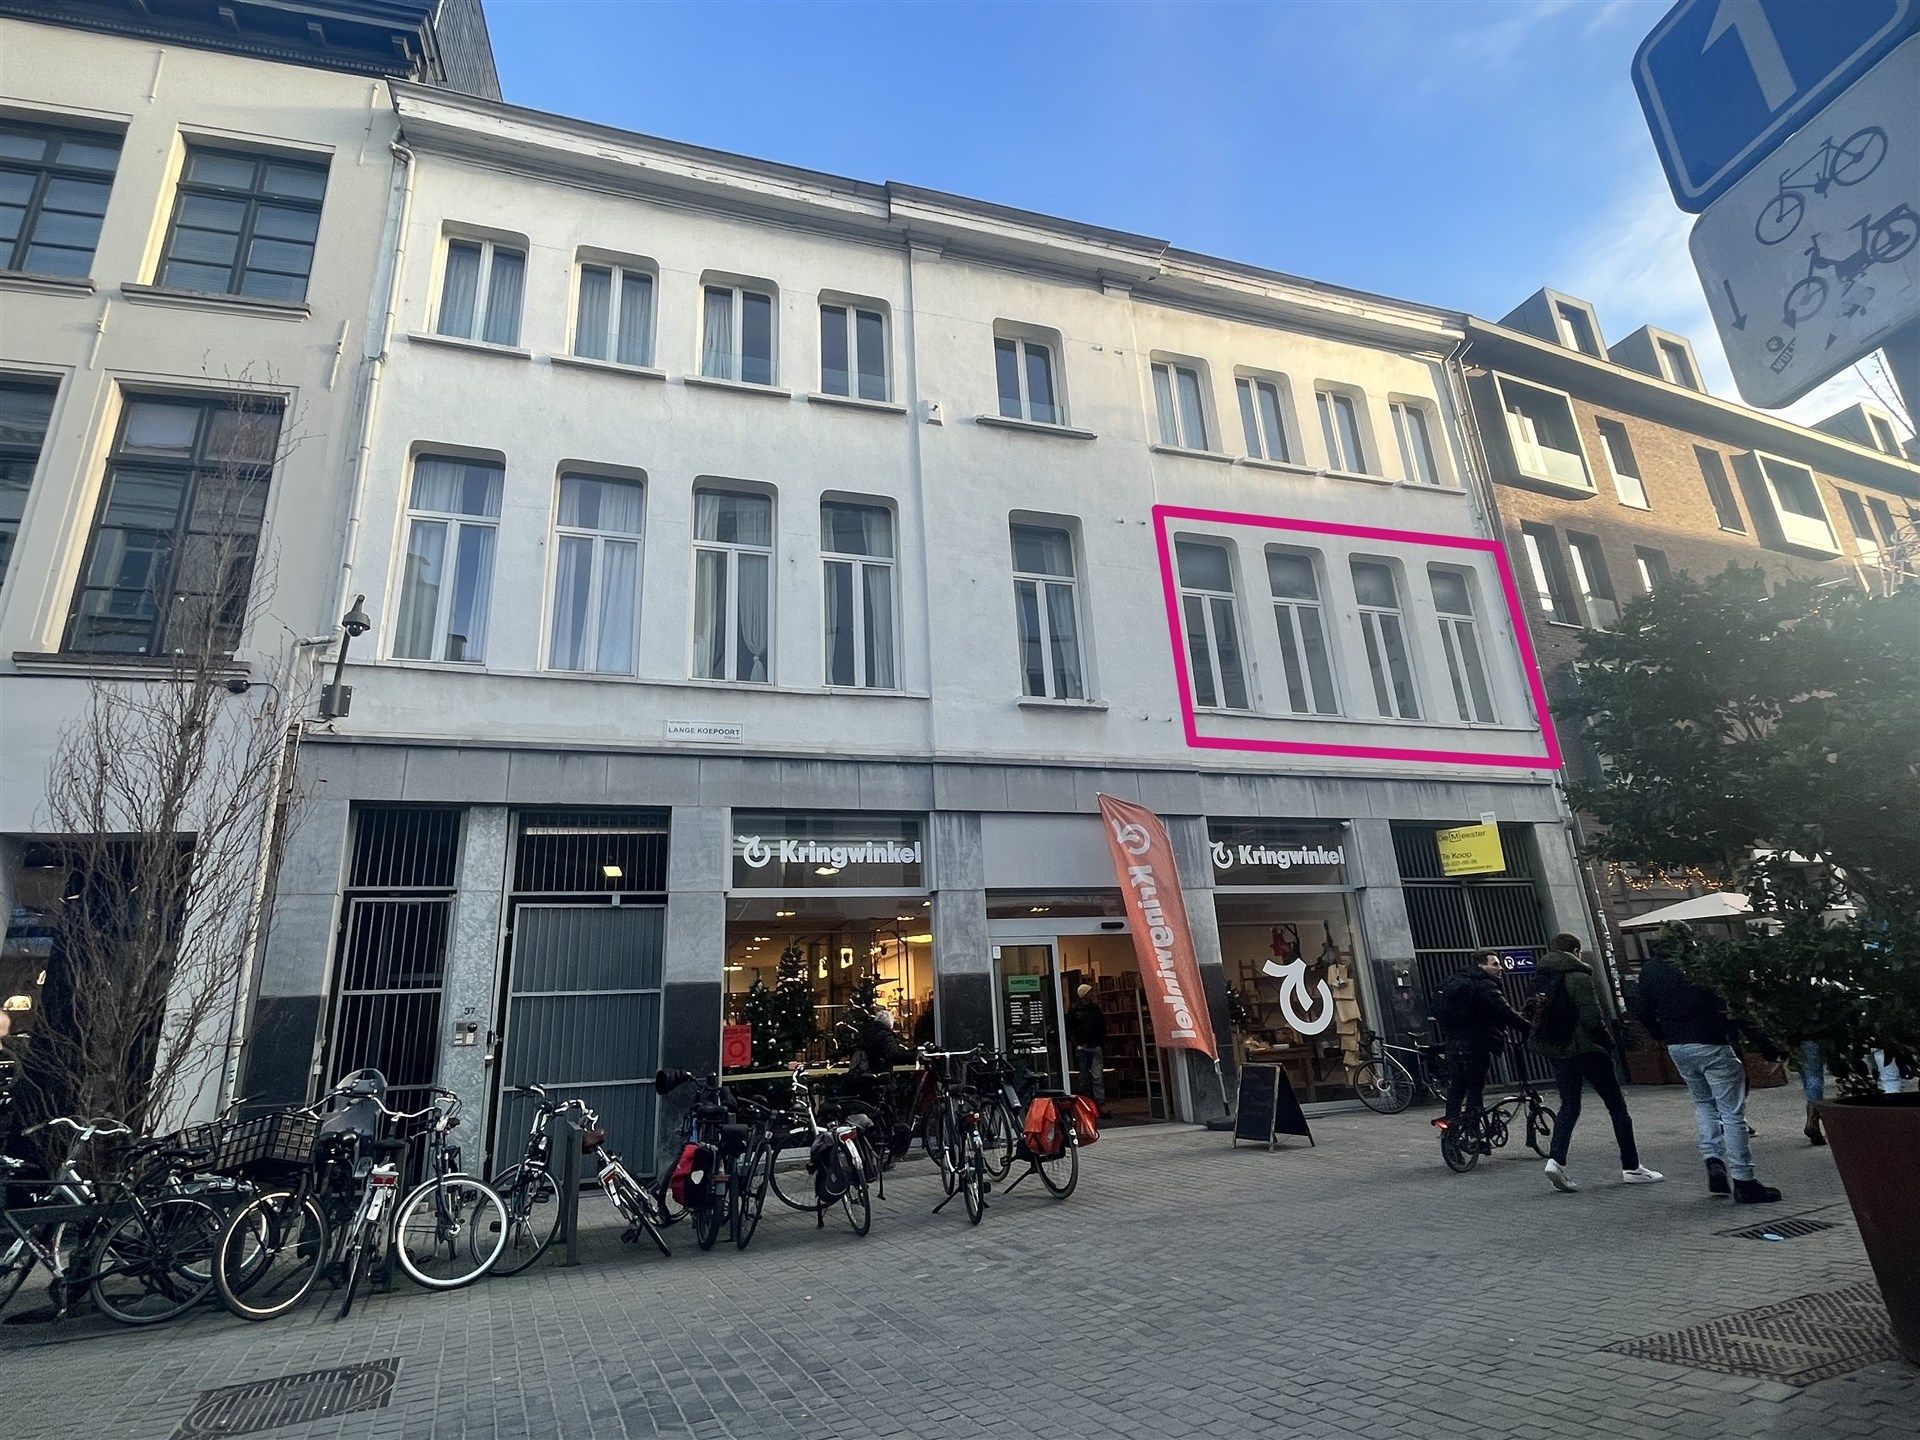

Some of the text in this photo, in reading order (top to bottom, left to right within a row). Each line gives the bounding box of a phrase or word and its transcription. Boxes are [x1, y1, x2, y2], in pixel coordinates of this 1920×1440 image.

[668, 726, 741, 736] LANGE KOEPOORT
[780, 840, 921, 868] Kringwinkel
[1238, 844, 1345, 869] Kringwinkel
[1451, 851, 1472, 860] Koop
[464, 1007, 476, 1015] 37
